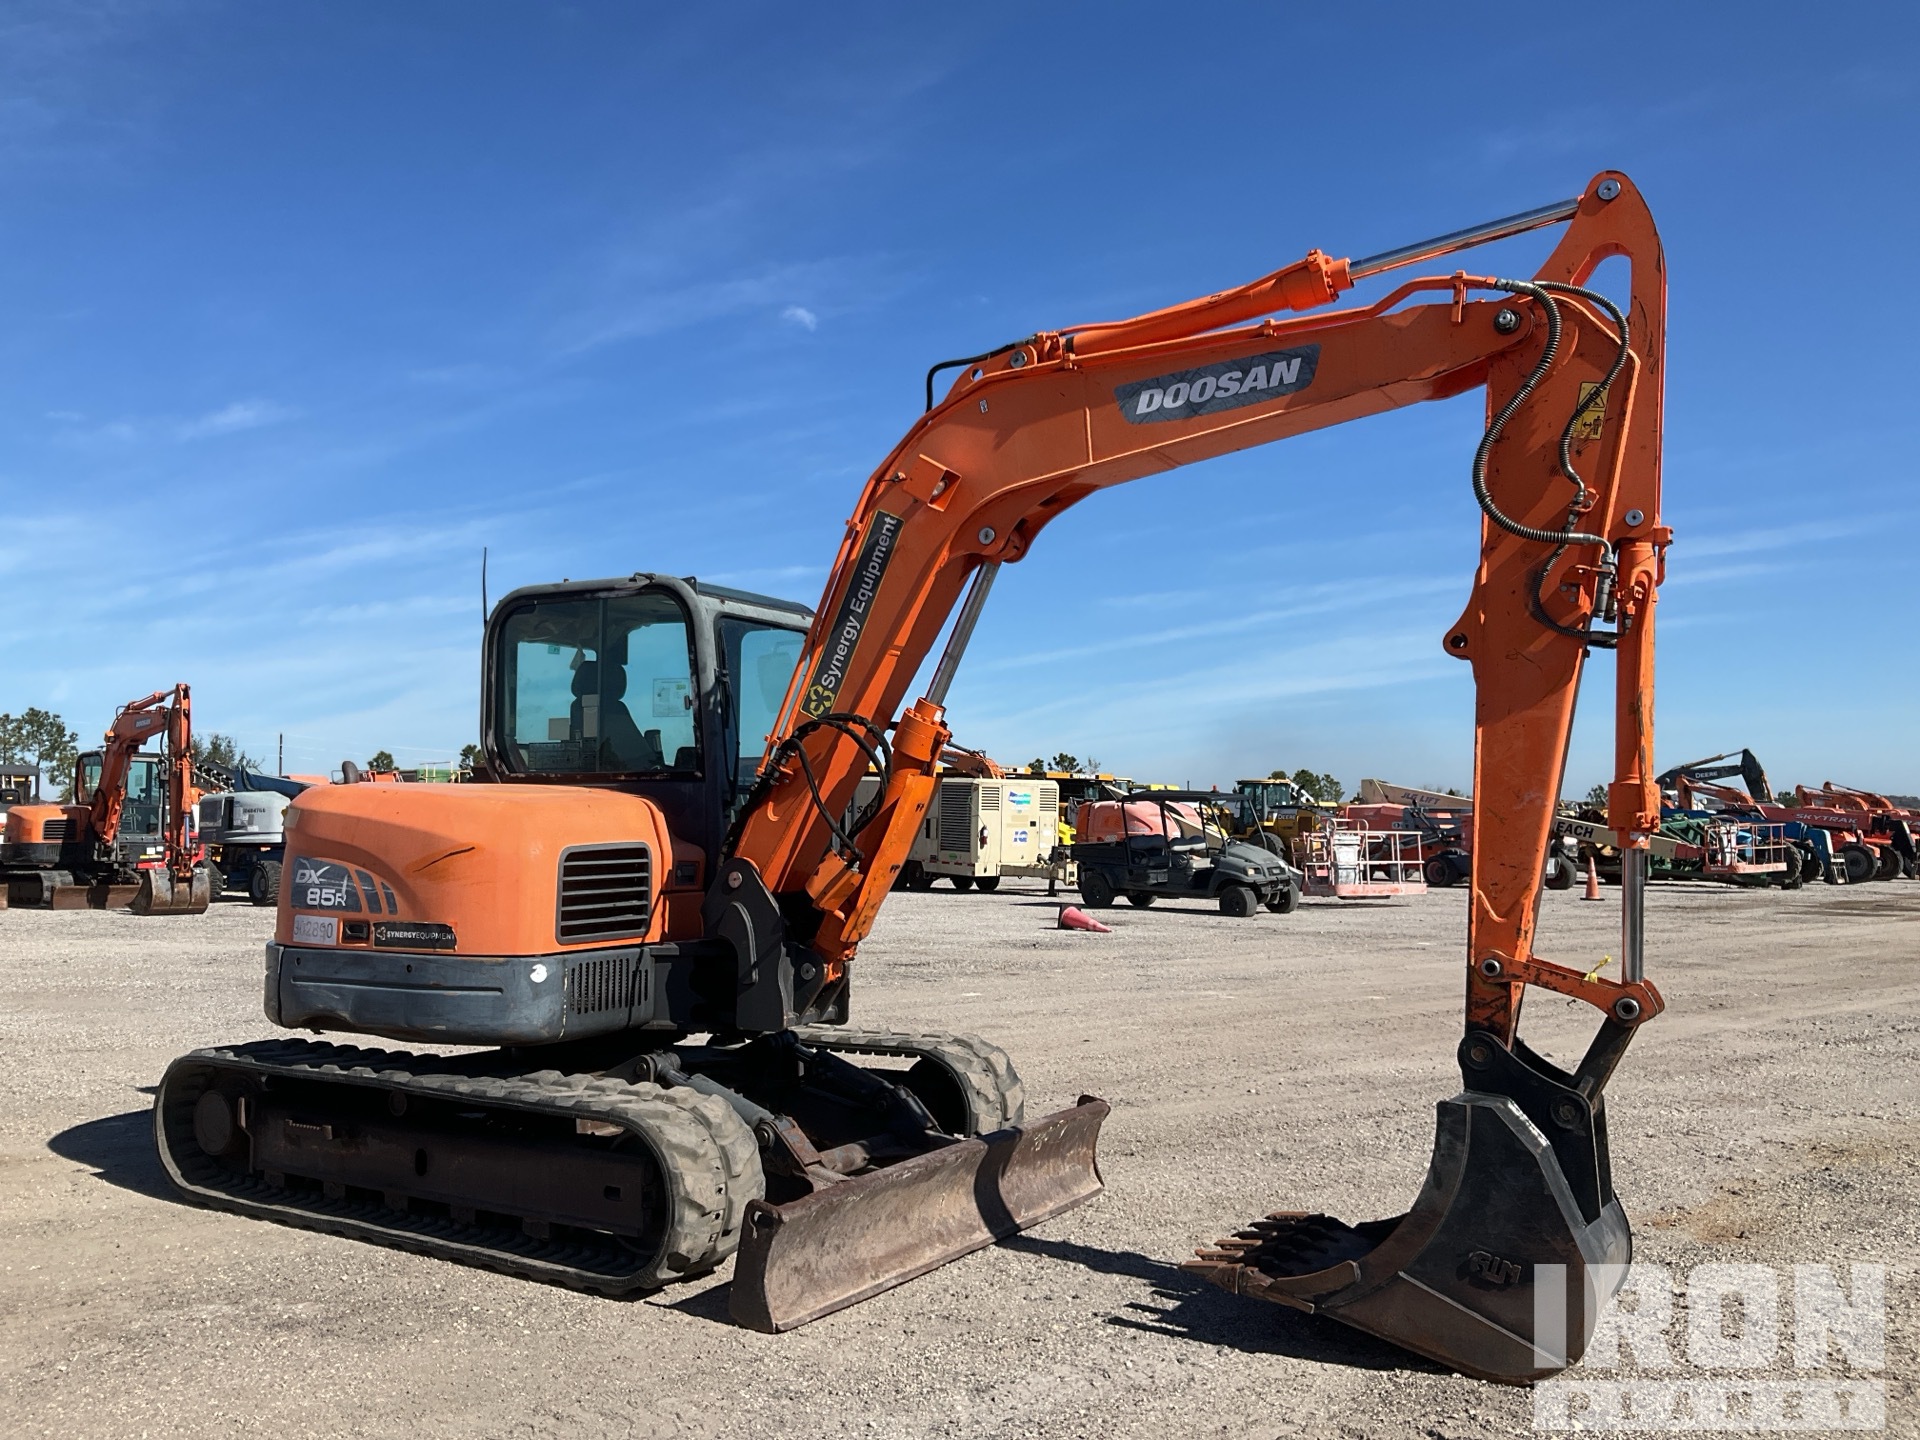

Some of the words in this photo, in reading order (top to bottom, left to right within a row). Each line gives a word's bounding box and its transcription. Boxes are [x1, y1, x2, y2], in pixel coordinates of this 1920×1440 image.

[1136, 358, 1301, 415] DOOSAN
[821, 615, 860, 688] Synergy
[850, 516, 898, 614] Equipment
[1695, 771, 1718, 779] DEERE
[1401, 792, 1418, 800] JLG
[1420, 795, 1440, 805] LIFT
[1796, 813, 1857, 824] SKYTRAK
[295, 866, 331, 885] DX
